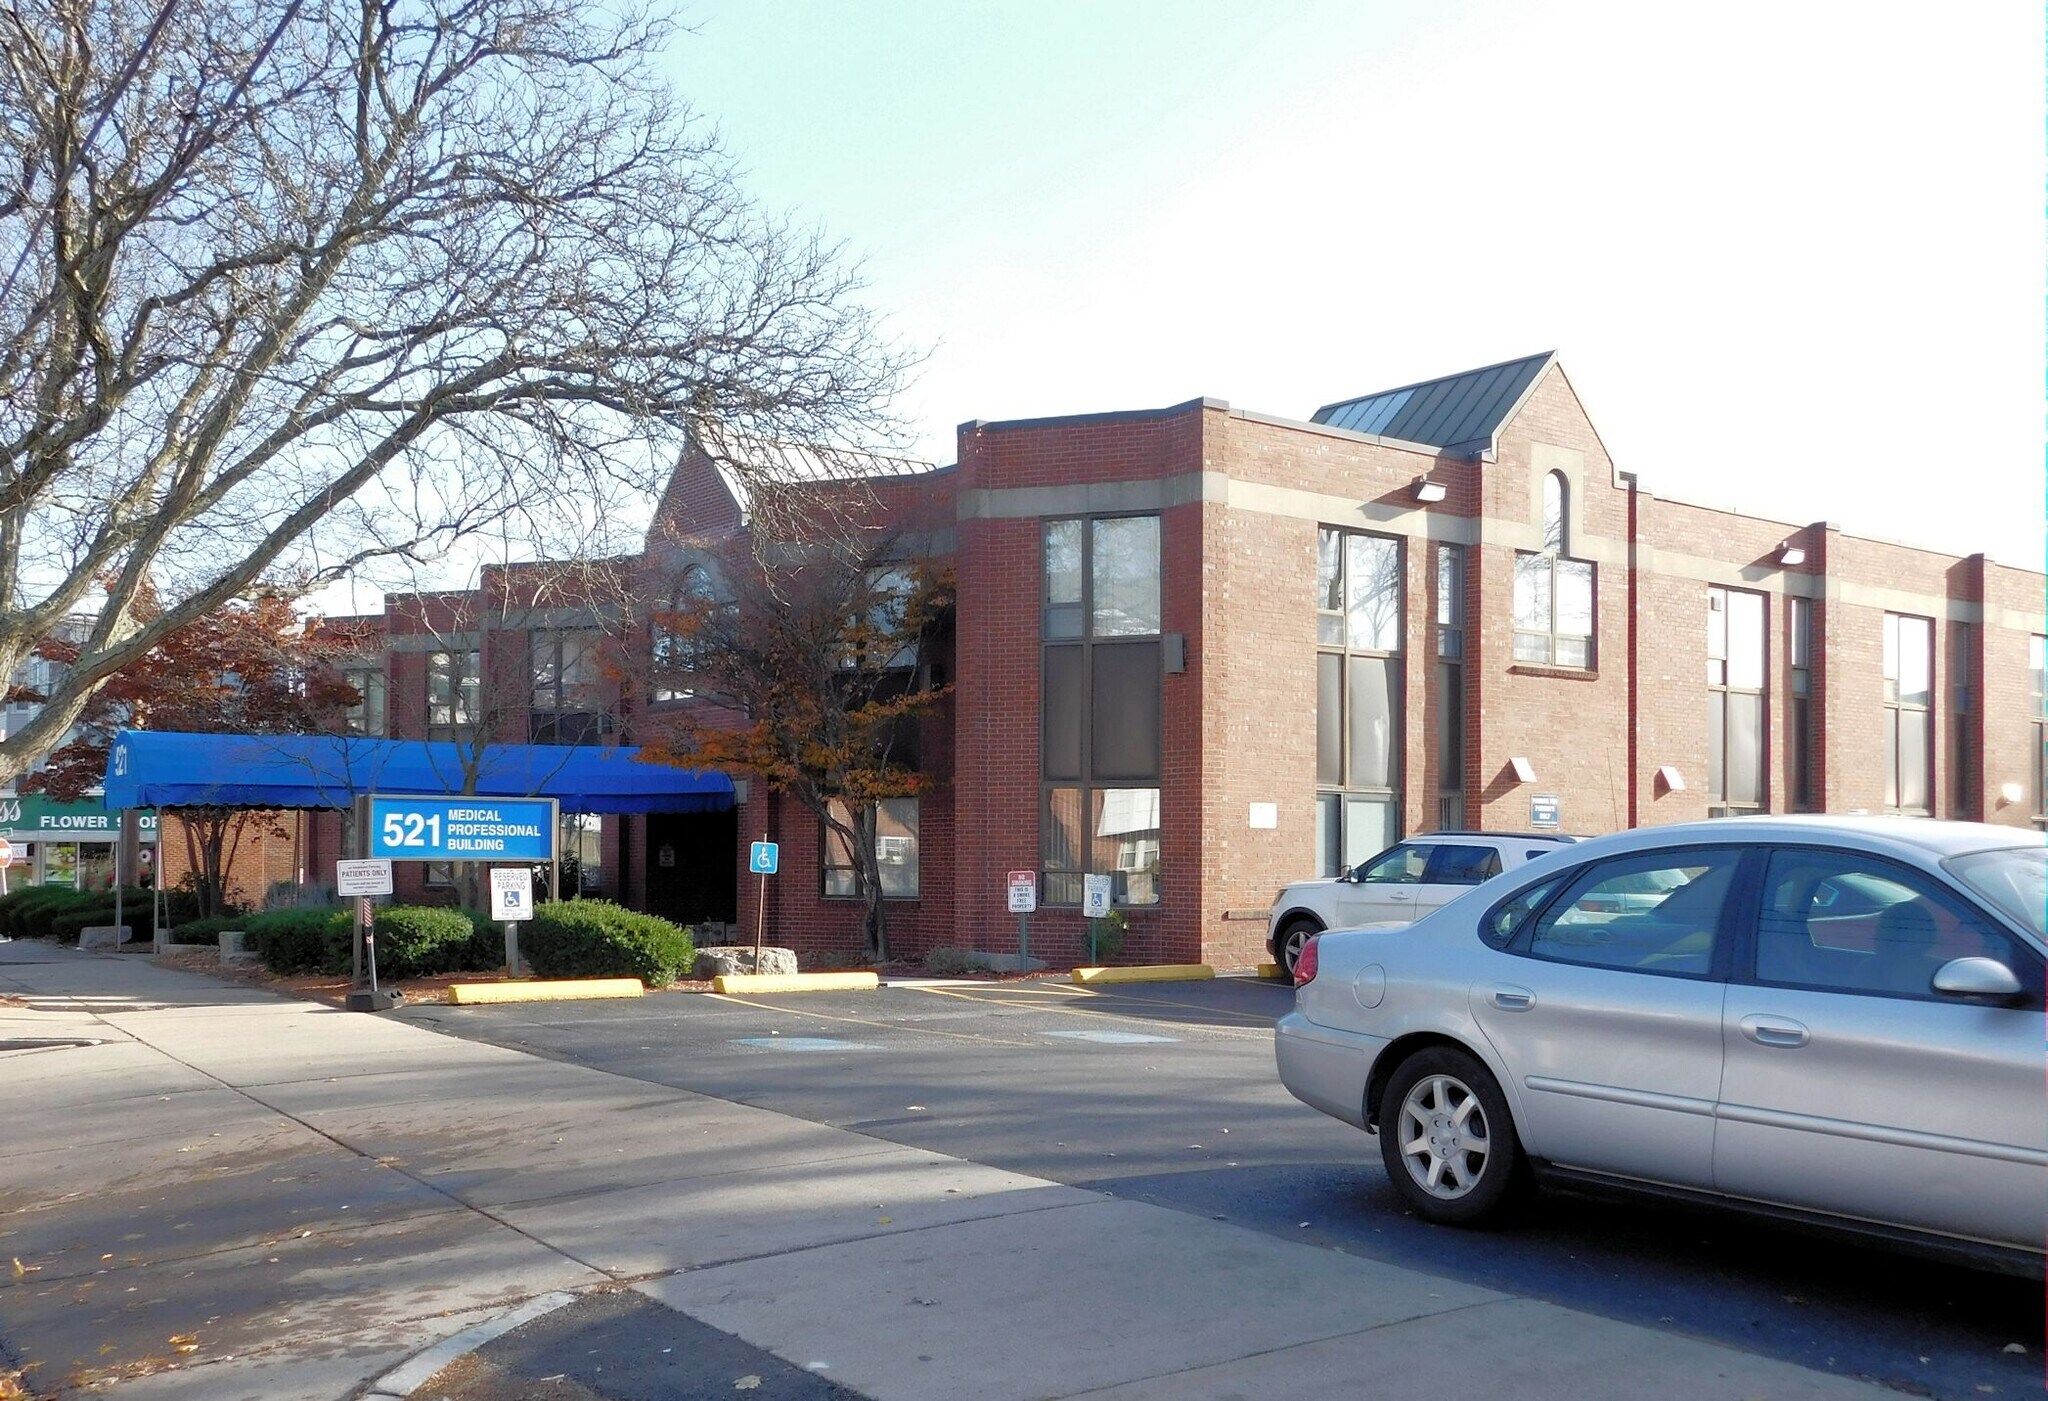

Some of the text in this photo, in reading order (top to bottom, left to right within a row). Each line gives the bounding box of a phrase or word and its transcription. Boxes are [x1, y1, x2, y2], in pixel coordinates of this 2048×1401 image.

[115, 744, 127, 776] 521
[448, 809, 501, 821] MEDICAL
[40, 815, 108, 828] FLOWER
[382, 812, 440, 847] 521
[448, 824, 541, 837] PROFESSIONAL
[448, 838, 504, 850] BUILDING
[341, 869, 387, 878] PATIENTS ONLY
[494, 872, 528, 881] RESERVED
[497, 881, 526, 890] PARKING
